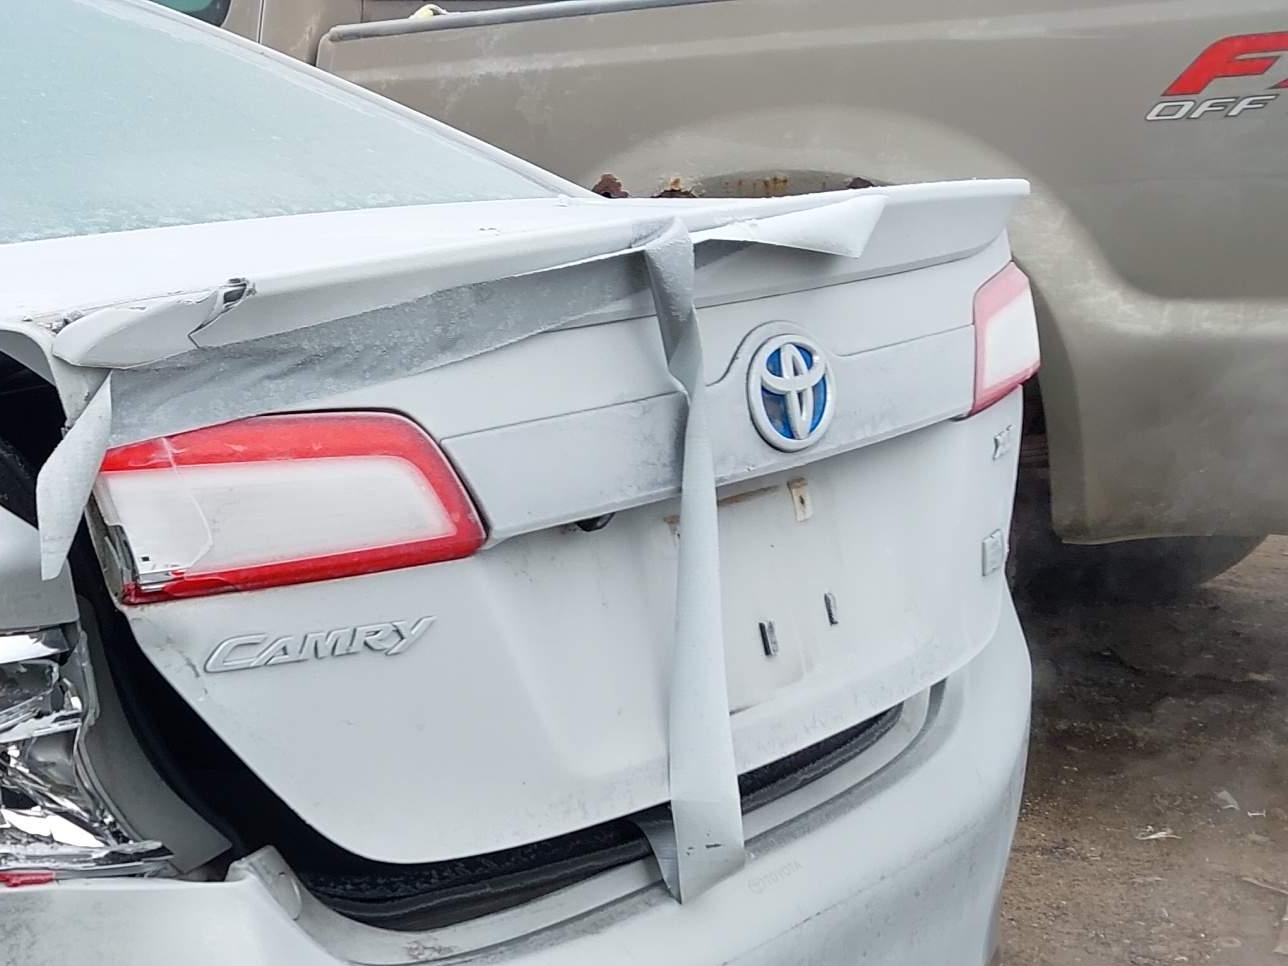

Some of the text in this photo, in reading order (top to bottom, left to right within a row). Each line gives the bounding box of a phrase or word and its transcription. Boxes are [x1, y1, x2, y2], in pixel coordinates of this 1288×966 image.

[1161, 31, 1288, 96] F
[1144, 94, 1280, 121] OFF
[203, 615, 437, 673] CAMRY
[762, 860, 803, 888] TOYOTA
